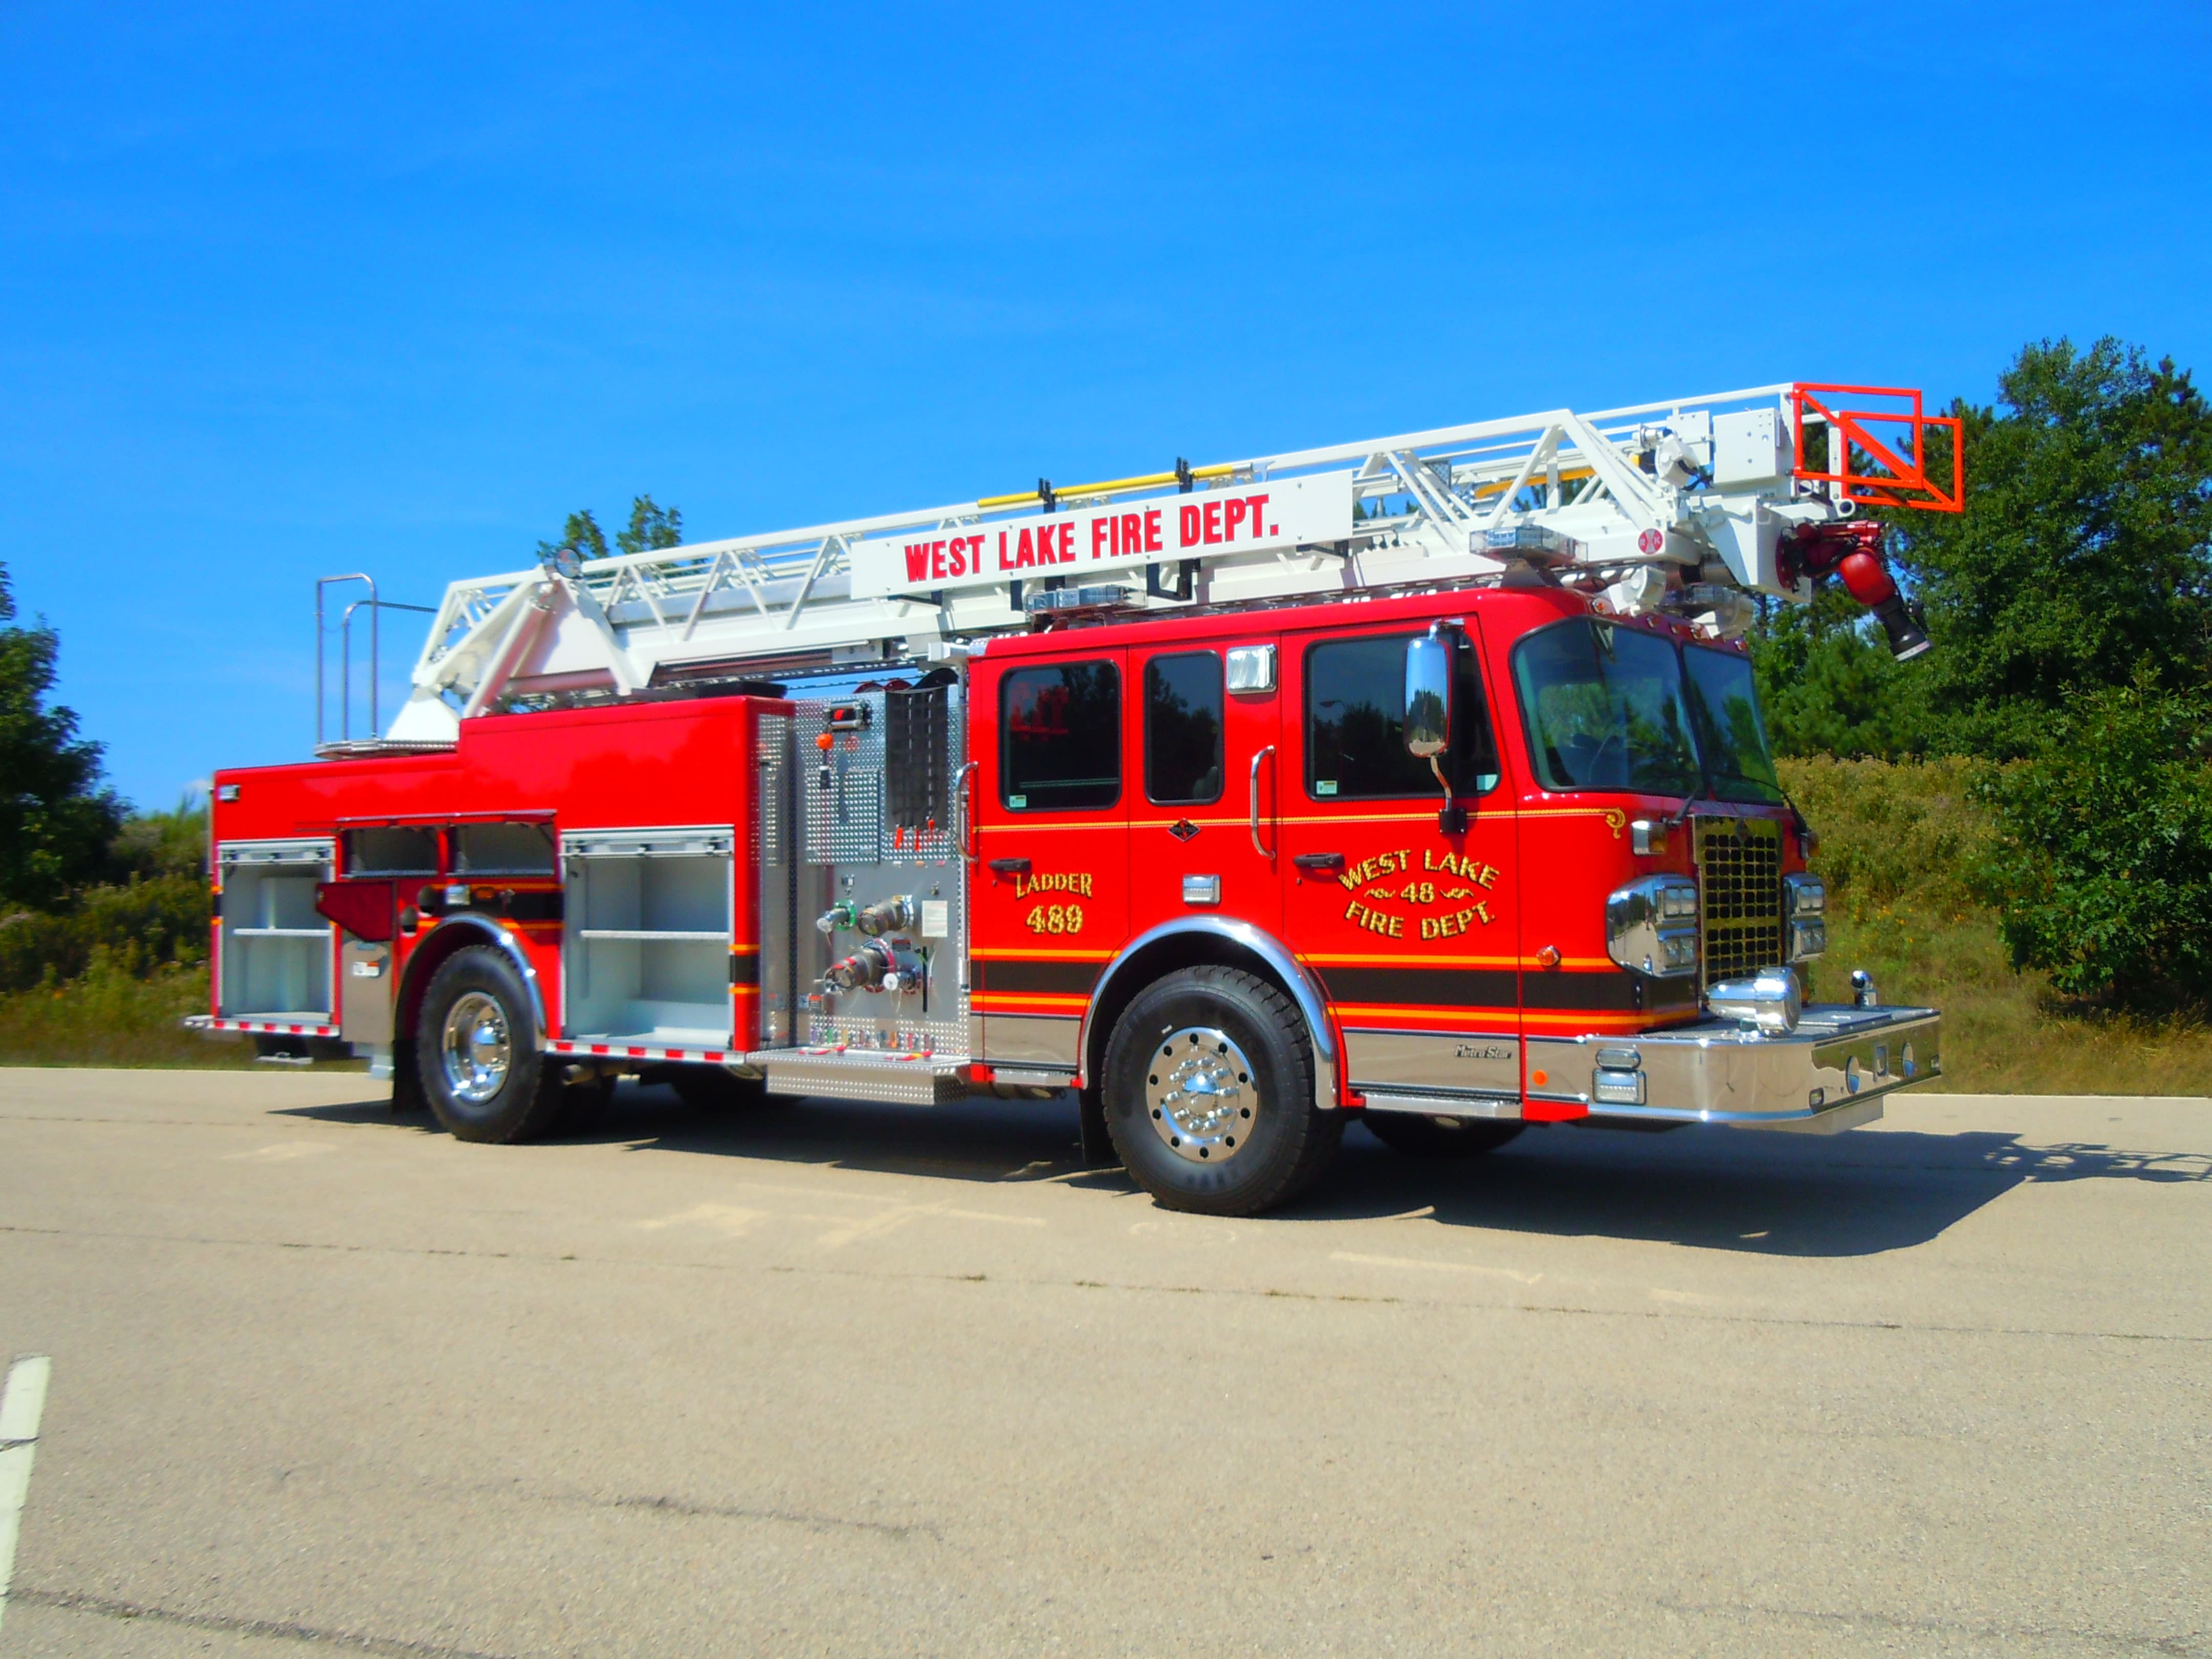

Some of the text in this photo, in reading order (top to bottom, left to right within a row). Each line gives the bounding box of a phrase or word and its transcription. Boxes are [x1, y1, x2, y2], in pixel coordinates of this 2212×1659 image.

[904, 493, 1279, 583] WEST LAKE FIRE DEPT.
[1016, 873, 1092, 900] LADDER
[1337, 849, 1500, 891] WEST LAKE
[1400, 882, 1435, 903] 48
[1026, 904, 1083, 934] 489
[1344, 900, 1496, 940] FIRE DEPT.
